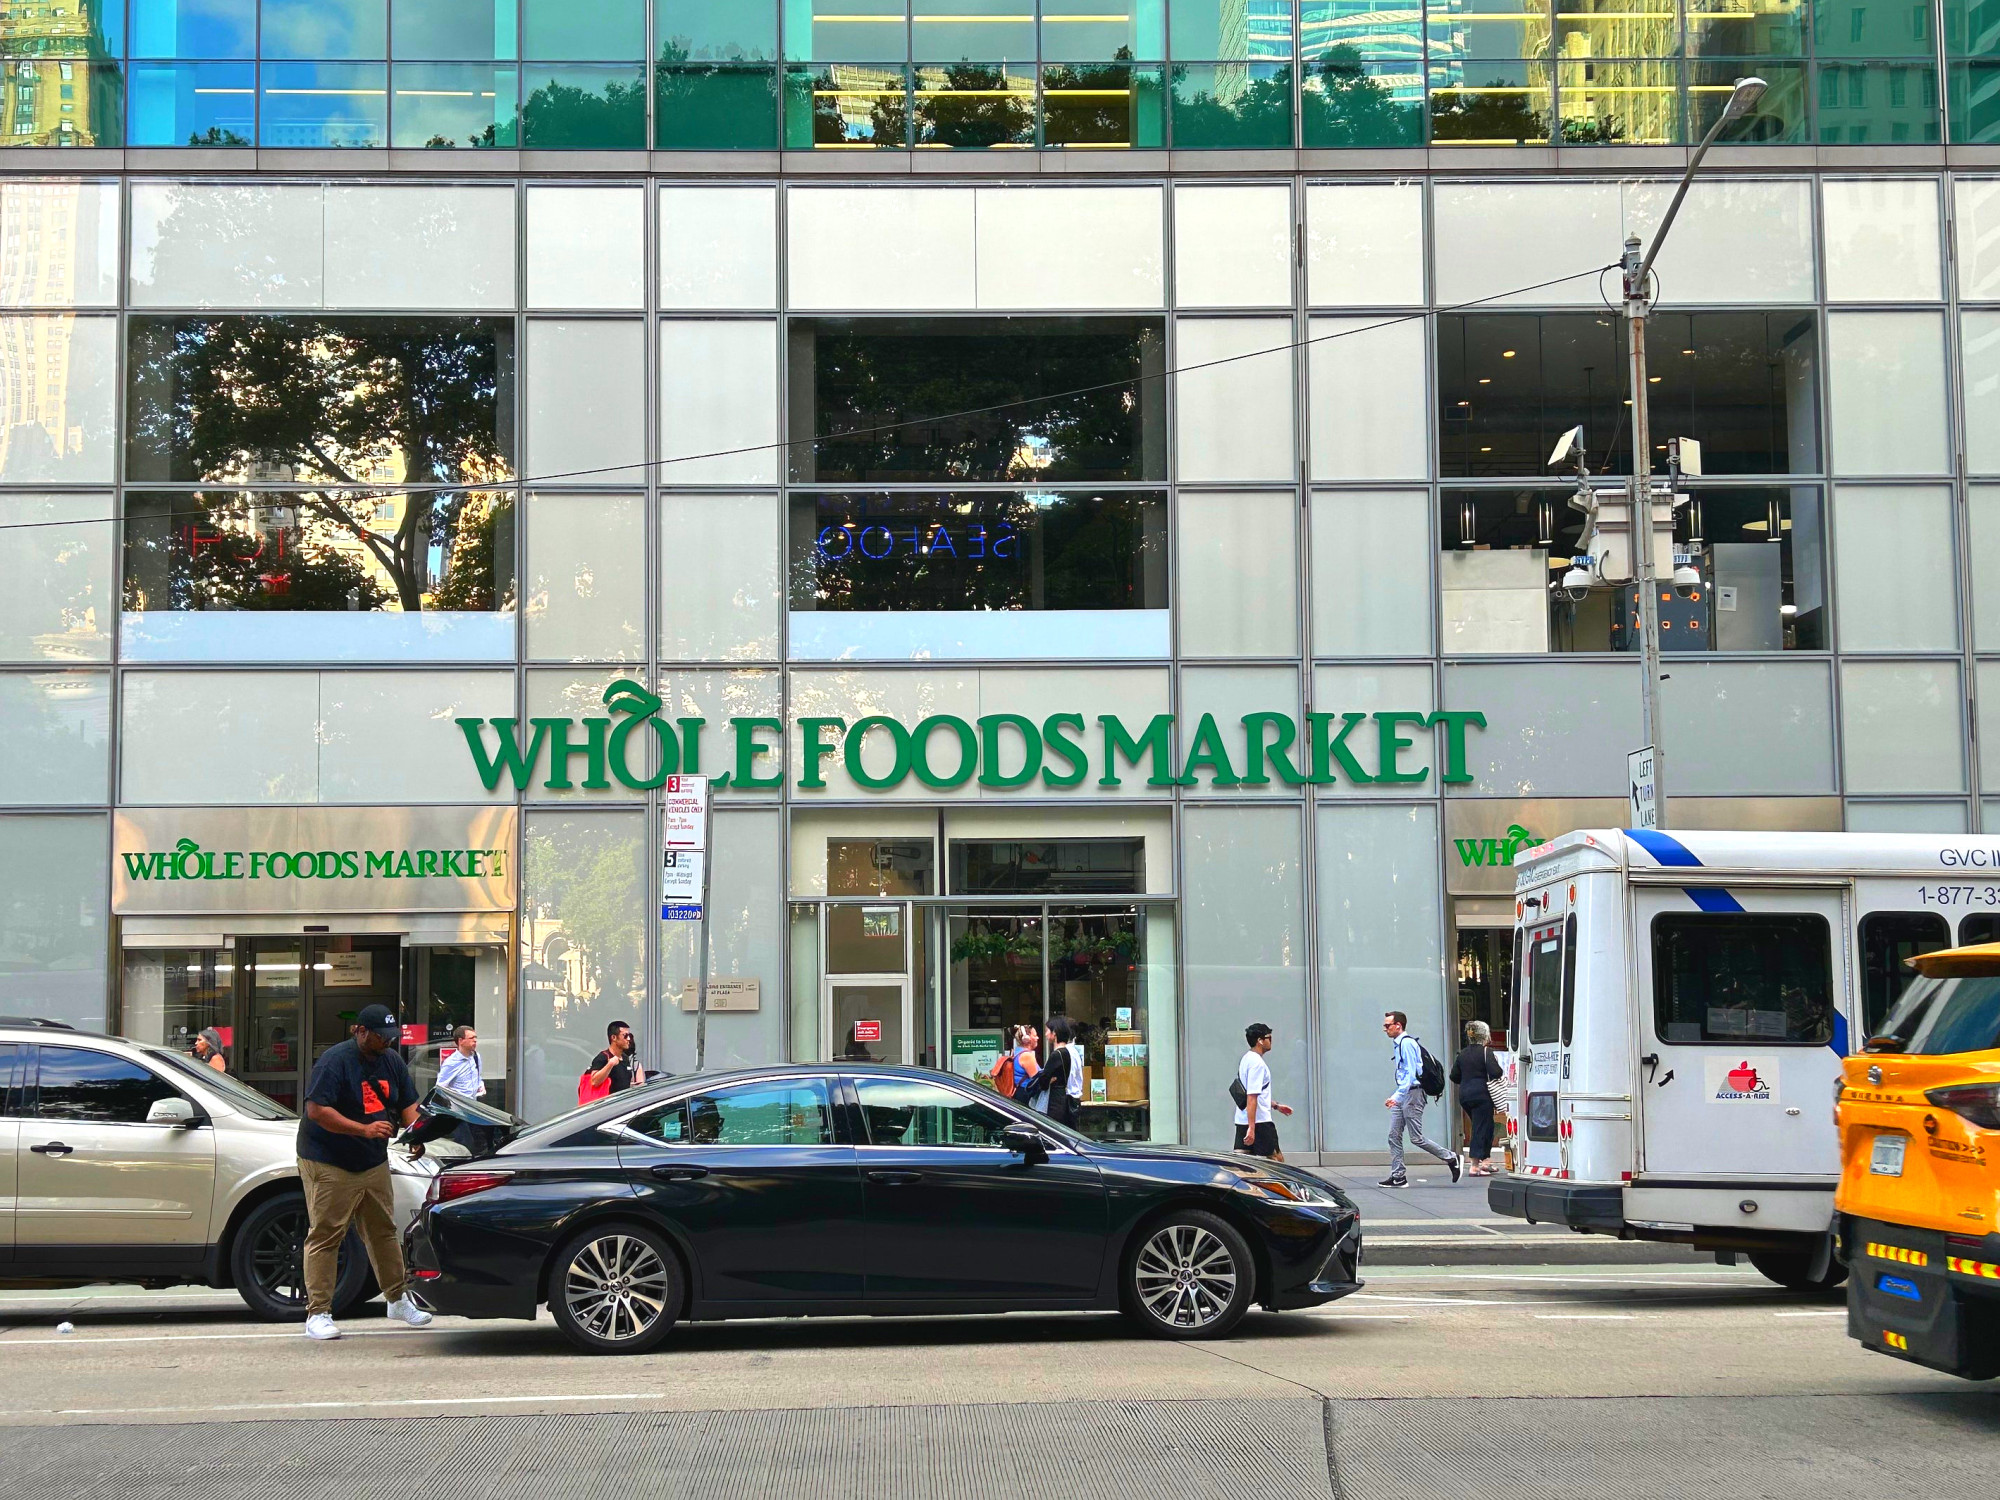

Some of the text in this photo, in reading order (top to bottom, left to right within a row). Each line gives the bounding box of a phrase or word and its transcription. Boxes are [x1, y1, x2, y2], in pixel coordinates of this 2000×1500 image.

[454, 679, 1488, 791] WHOLE FOODS MARKET
[1639, 758, 1653, 778] LEFT
[670, 777, 678, 792] 3
[1639, 783, 1654, 802] TURN
[1640, 808, 1655, 828] LANE
[1453, 824, 1546, 867] WHO
[120, 838, 509, 881] WHOLE FOODS MARKET
[666, 851, 675, 867] 5
[1939, 848, 1987, 867] GVC
[1918, 886, 2000, 905] 1-877-3
